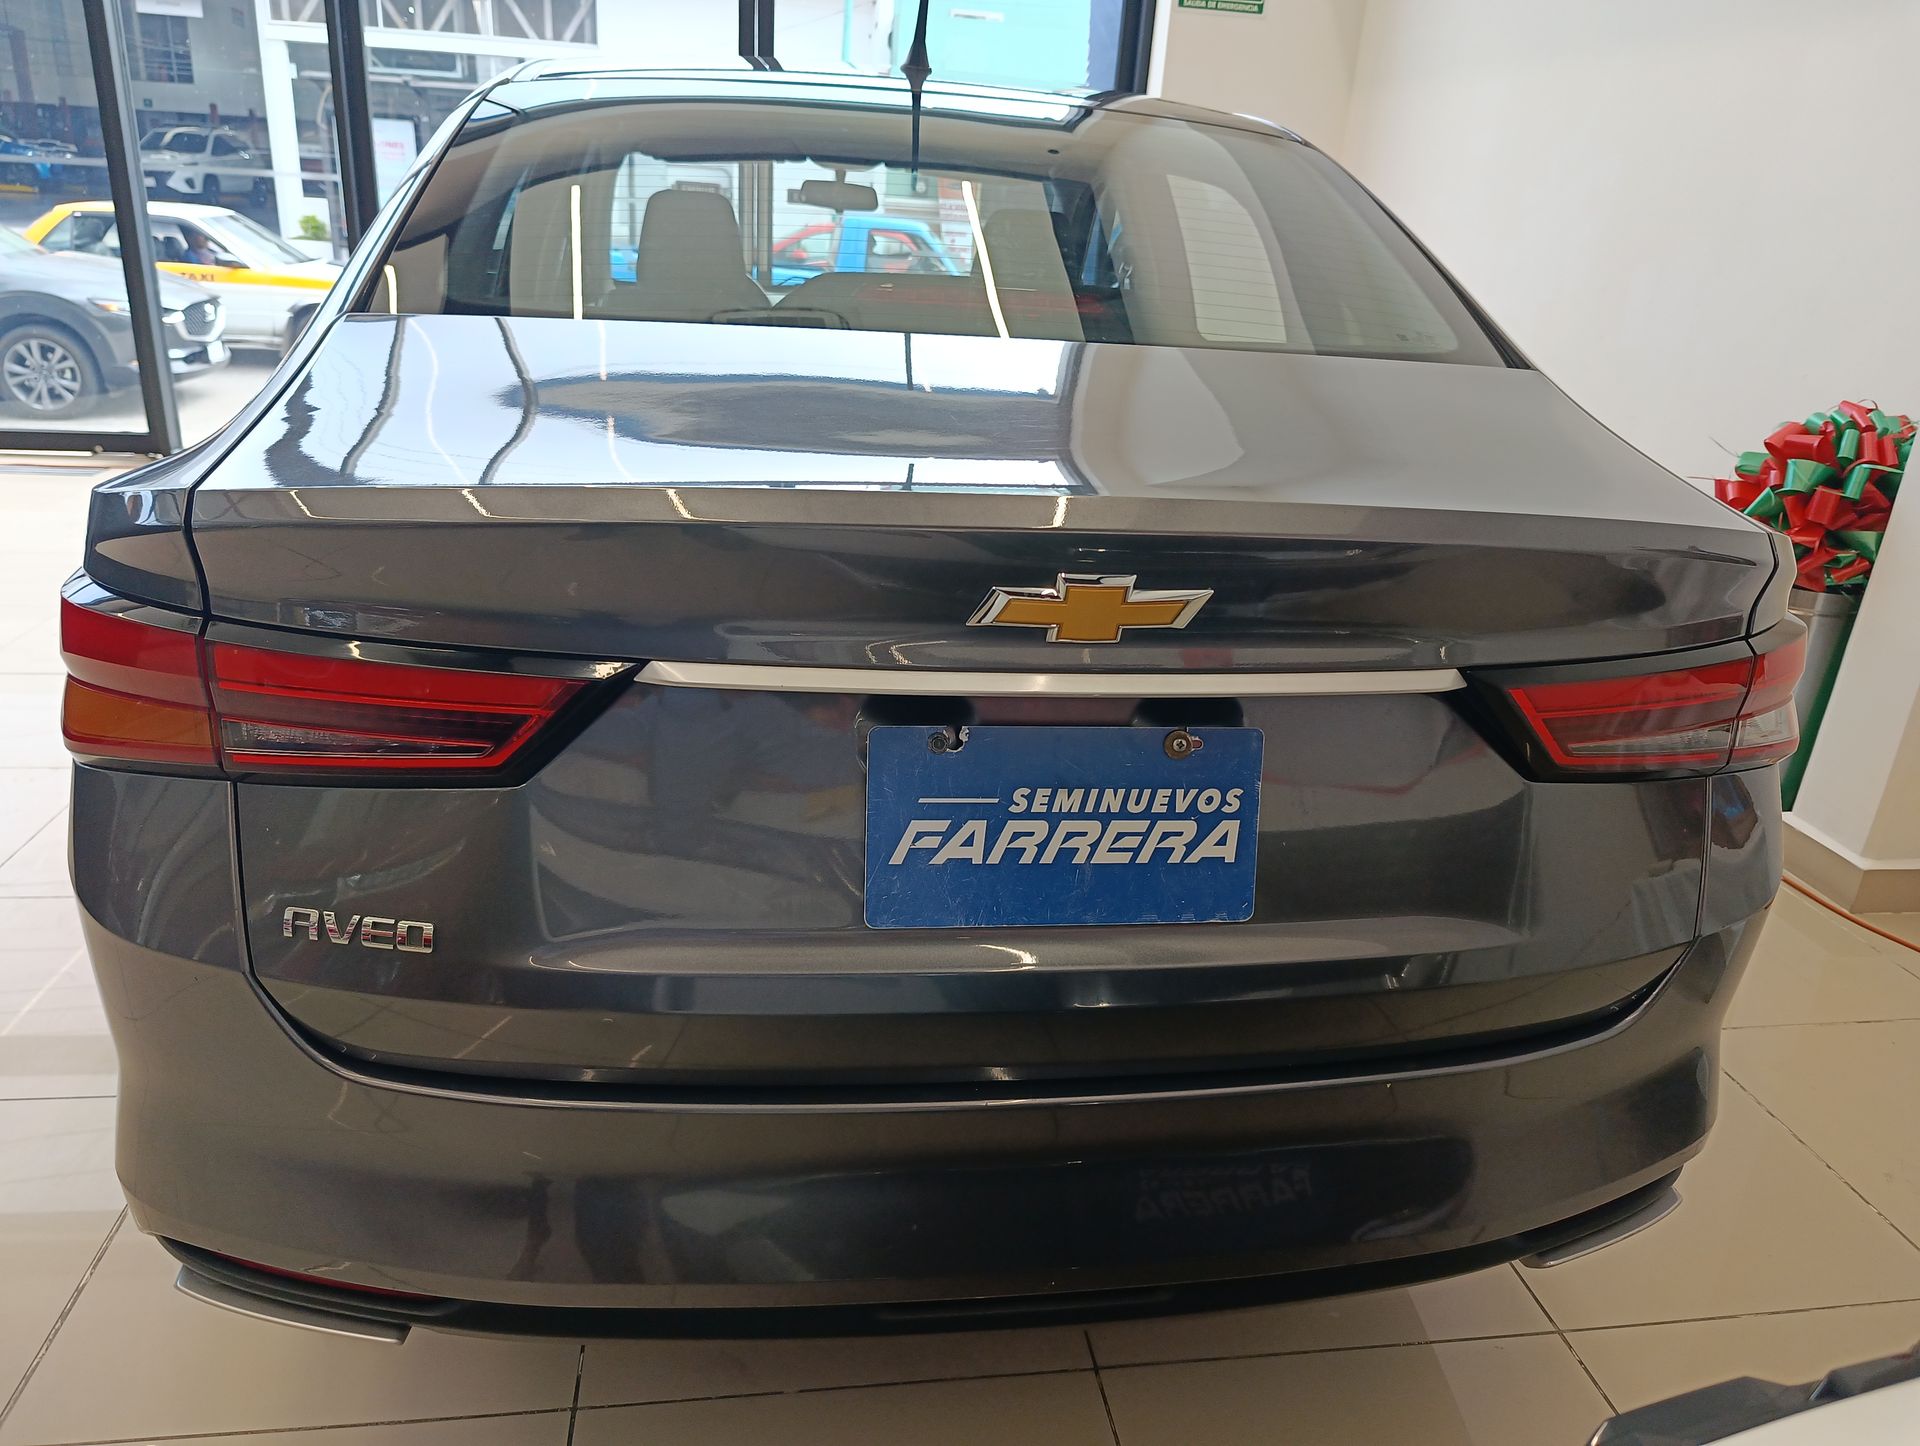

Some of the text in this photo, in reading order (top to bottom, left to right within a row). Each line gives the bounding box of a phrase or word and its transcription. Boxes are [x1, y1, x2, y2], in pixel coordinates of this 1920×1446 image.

[1008, 787, 1244, 813] SEMINUEVOS
[888, 819, 1240, 865] FARRERA
[283, 906, 434, 954] AVEO
